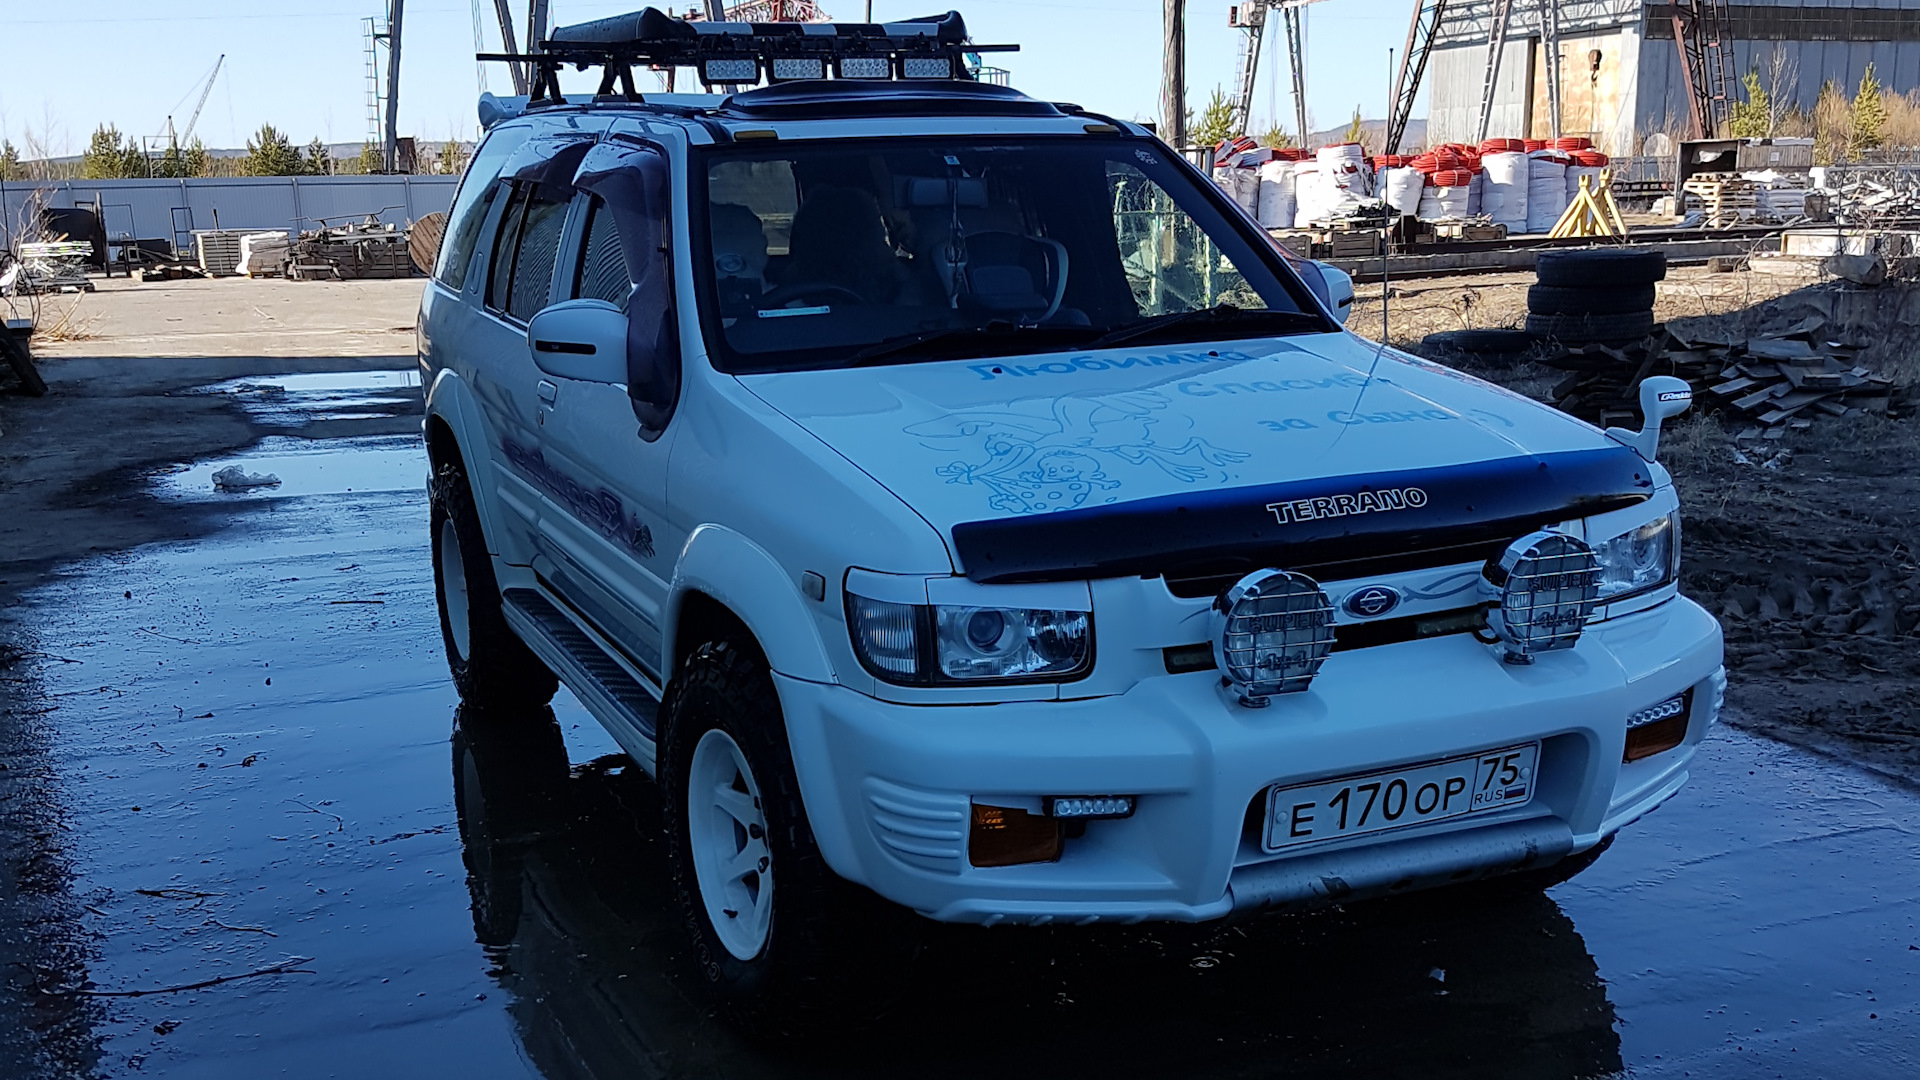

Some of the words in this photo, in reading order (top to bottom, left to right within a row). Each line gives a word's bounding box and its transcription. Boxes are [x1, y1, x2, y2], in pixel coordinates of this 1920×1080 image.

[1257, 418, 1319, 431] за
[1266, 487, 1428, 524] TERRANO
[1250, 612, 1324, 634] SUPER
[1482, 752, 1521, 791] 75
[1474, 789, 1503, 805] RUS
